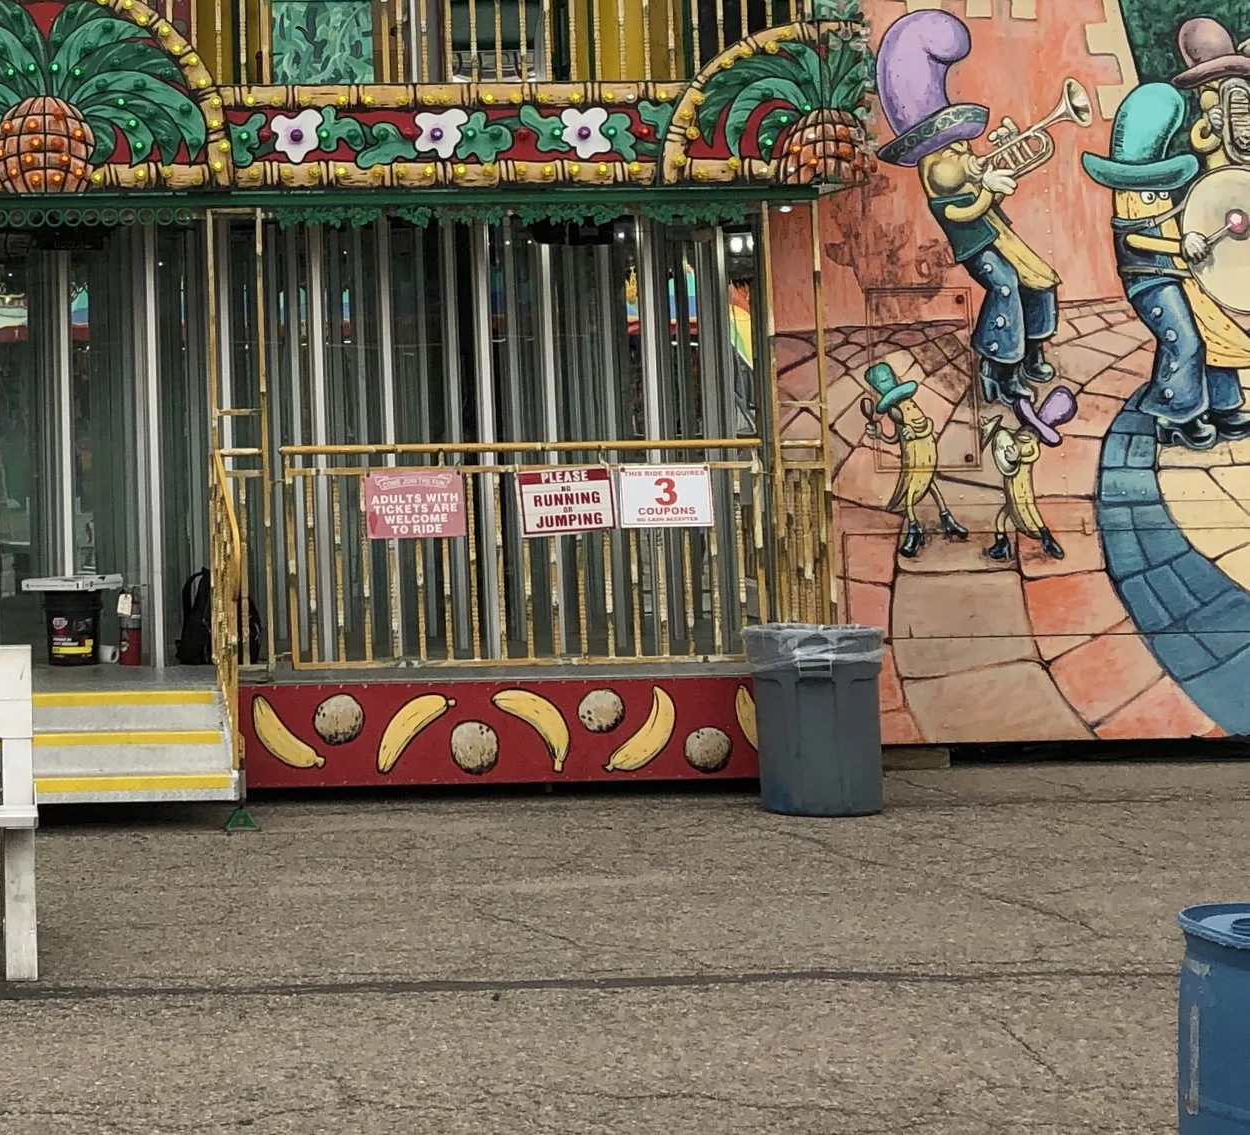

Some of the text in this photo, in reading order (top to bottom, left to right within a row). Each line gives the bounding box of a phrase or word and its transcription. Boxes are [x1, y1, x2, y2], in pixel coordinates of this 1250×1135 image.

[540, 470, 589, 484] PLEASE
[653, 477, 678, 506] 3
[371, 492, 459, 504] ADULTS WITH
[533, 491, 601, 507] RUNNING
[373, 503, 458, 514] TICKETS ARE
[638, 506, 696, 515] COUPONS
[384, 513, 448, 524] WELCOME
[536, 512, 603, 528] JUMPING
[391, 523, 443, 534] TO RIDE
